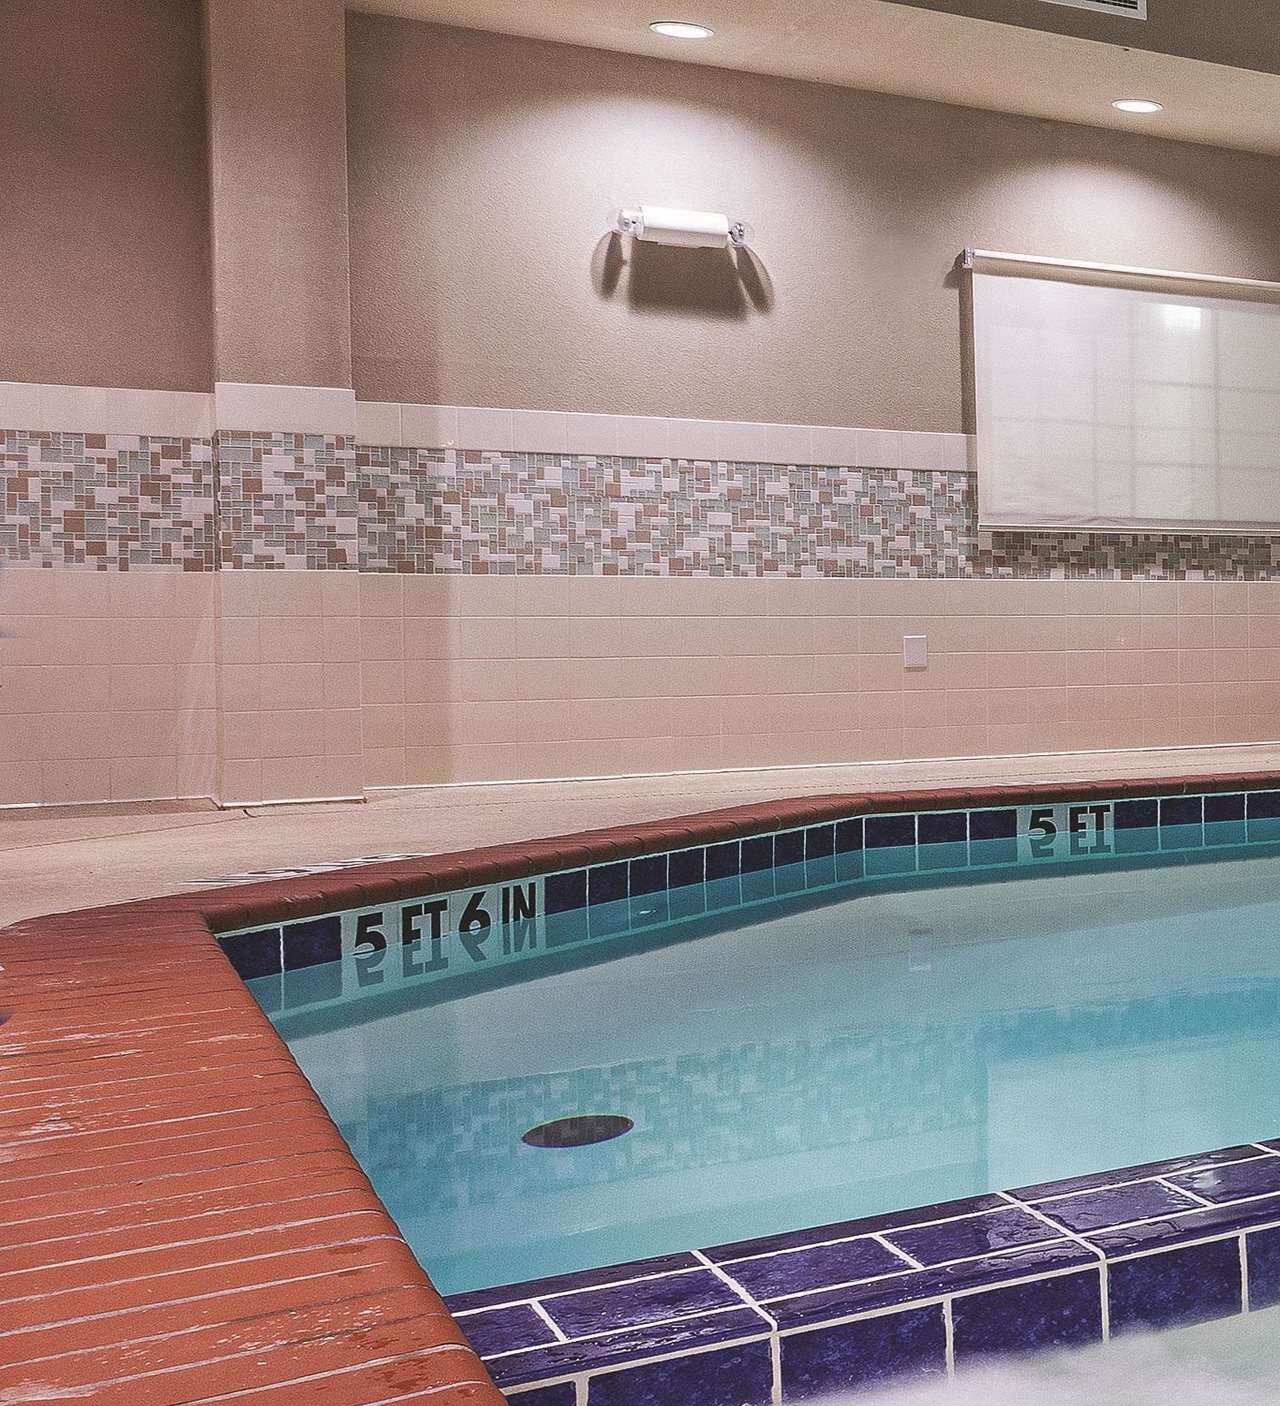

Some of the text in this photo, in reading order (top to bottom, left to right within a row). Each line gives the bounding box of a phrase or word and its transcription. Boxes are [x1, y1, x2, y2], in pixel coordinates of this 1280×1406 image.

[1028, 808, 1057, 835] 5
[354, 911, 388, 956] 5
[459, 891, 491, 933] 6
[502, 882, 536, 926] IN
